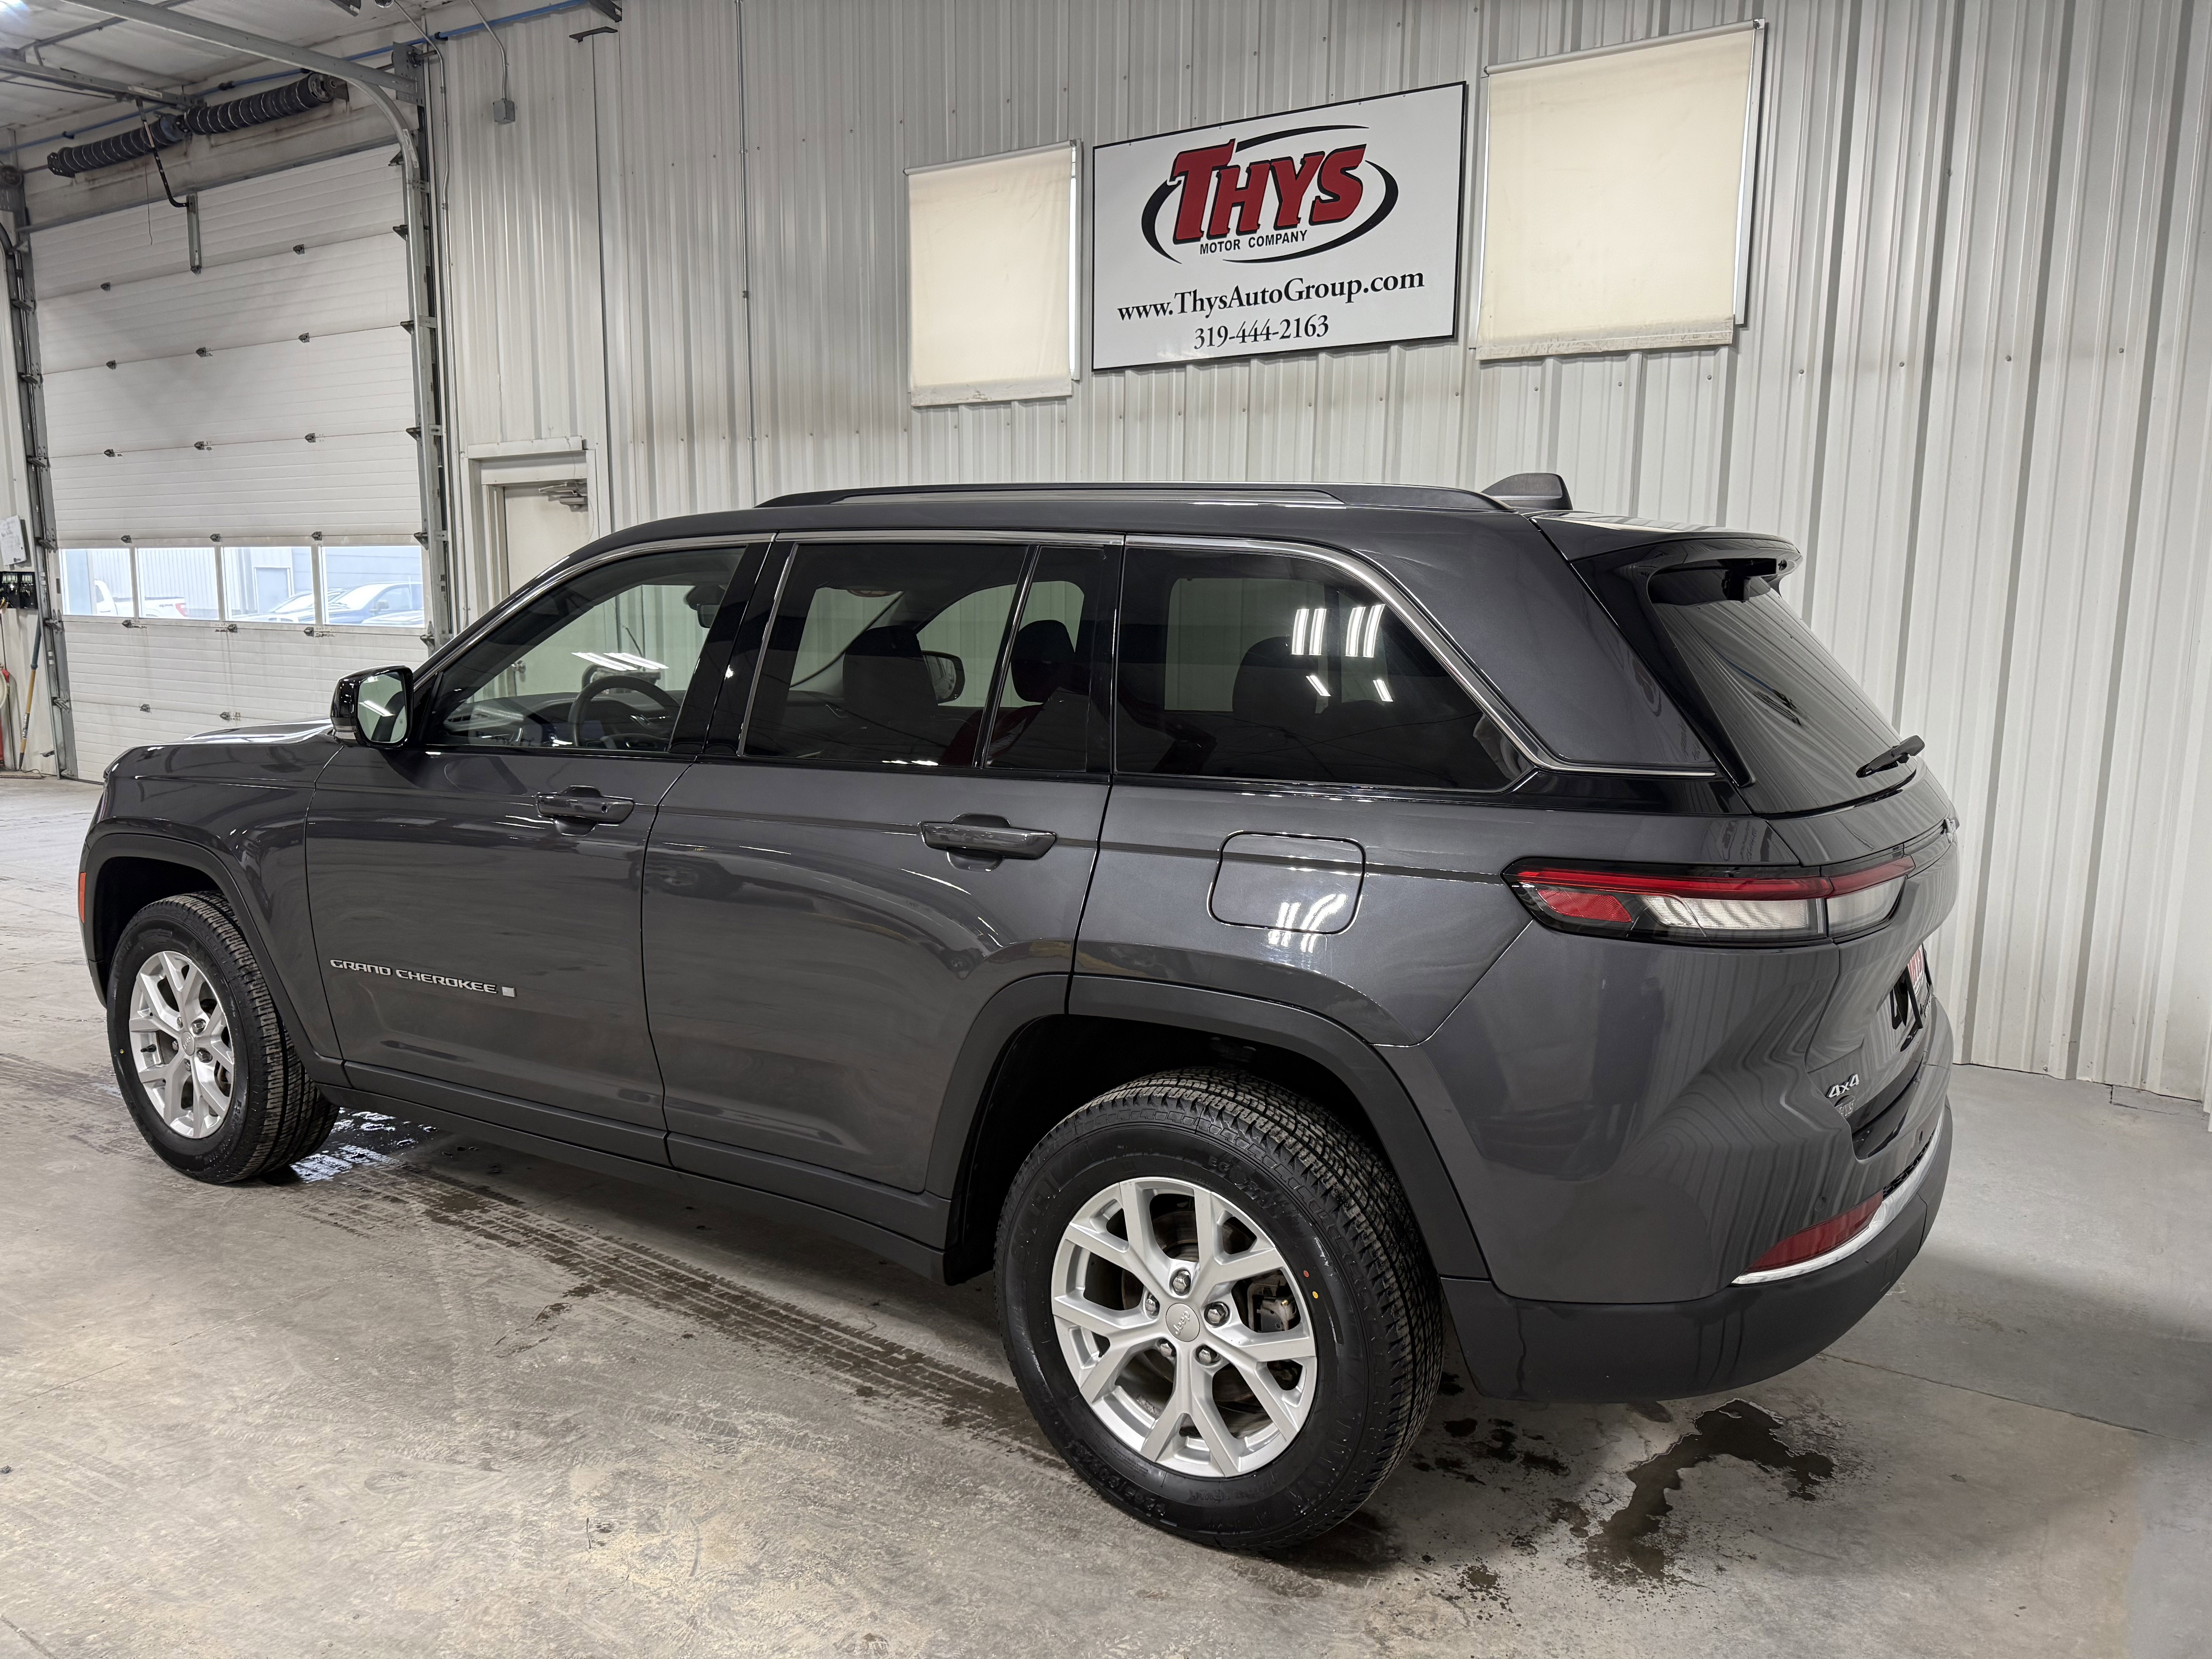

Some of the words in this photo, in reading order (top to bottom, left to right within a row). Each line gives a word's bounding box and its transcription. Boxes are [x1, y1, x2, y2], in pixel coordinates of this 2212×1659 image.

[1169, 138, 1367, 245] THYS
[1200, 239, 1241, 255] MOTOR
[1248, 229, 1308, 248] COMPANY
[1117, 272, 1425, 321] www.ThysAutoGroup.com
[1194, 314, 1329, 350] 319-444-2163
[330, 959, 391, 975] GRAND
[396, 969, 497, 994] CHEROKEE
[1827, 1073, 1860, 1098] 4x4
[1173, 1310, 1190, 1335] Jeep
